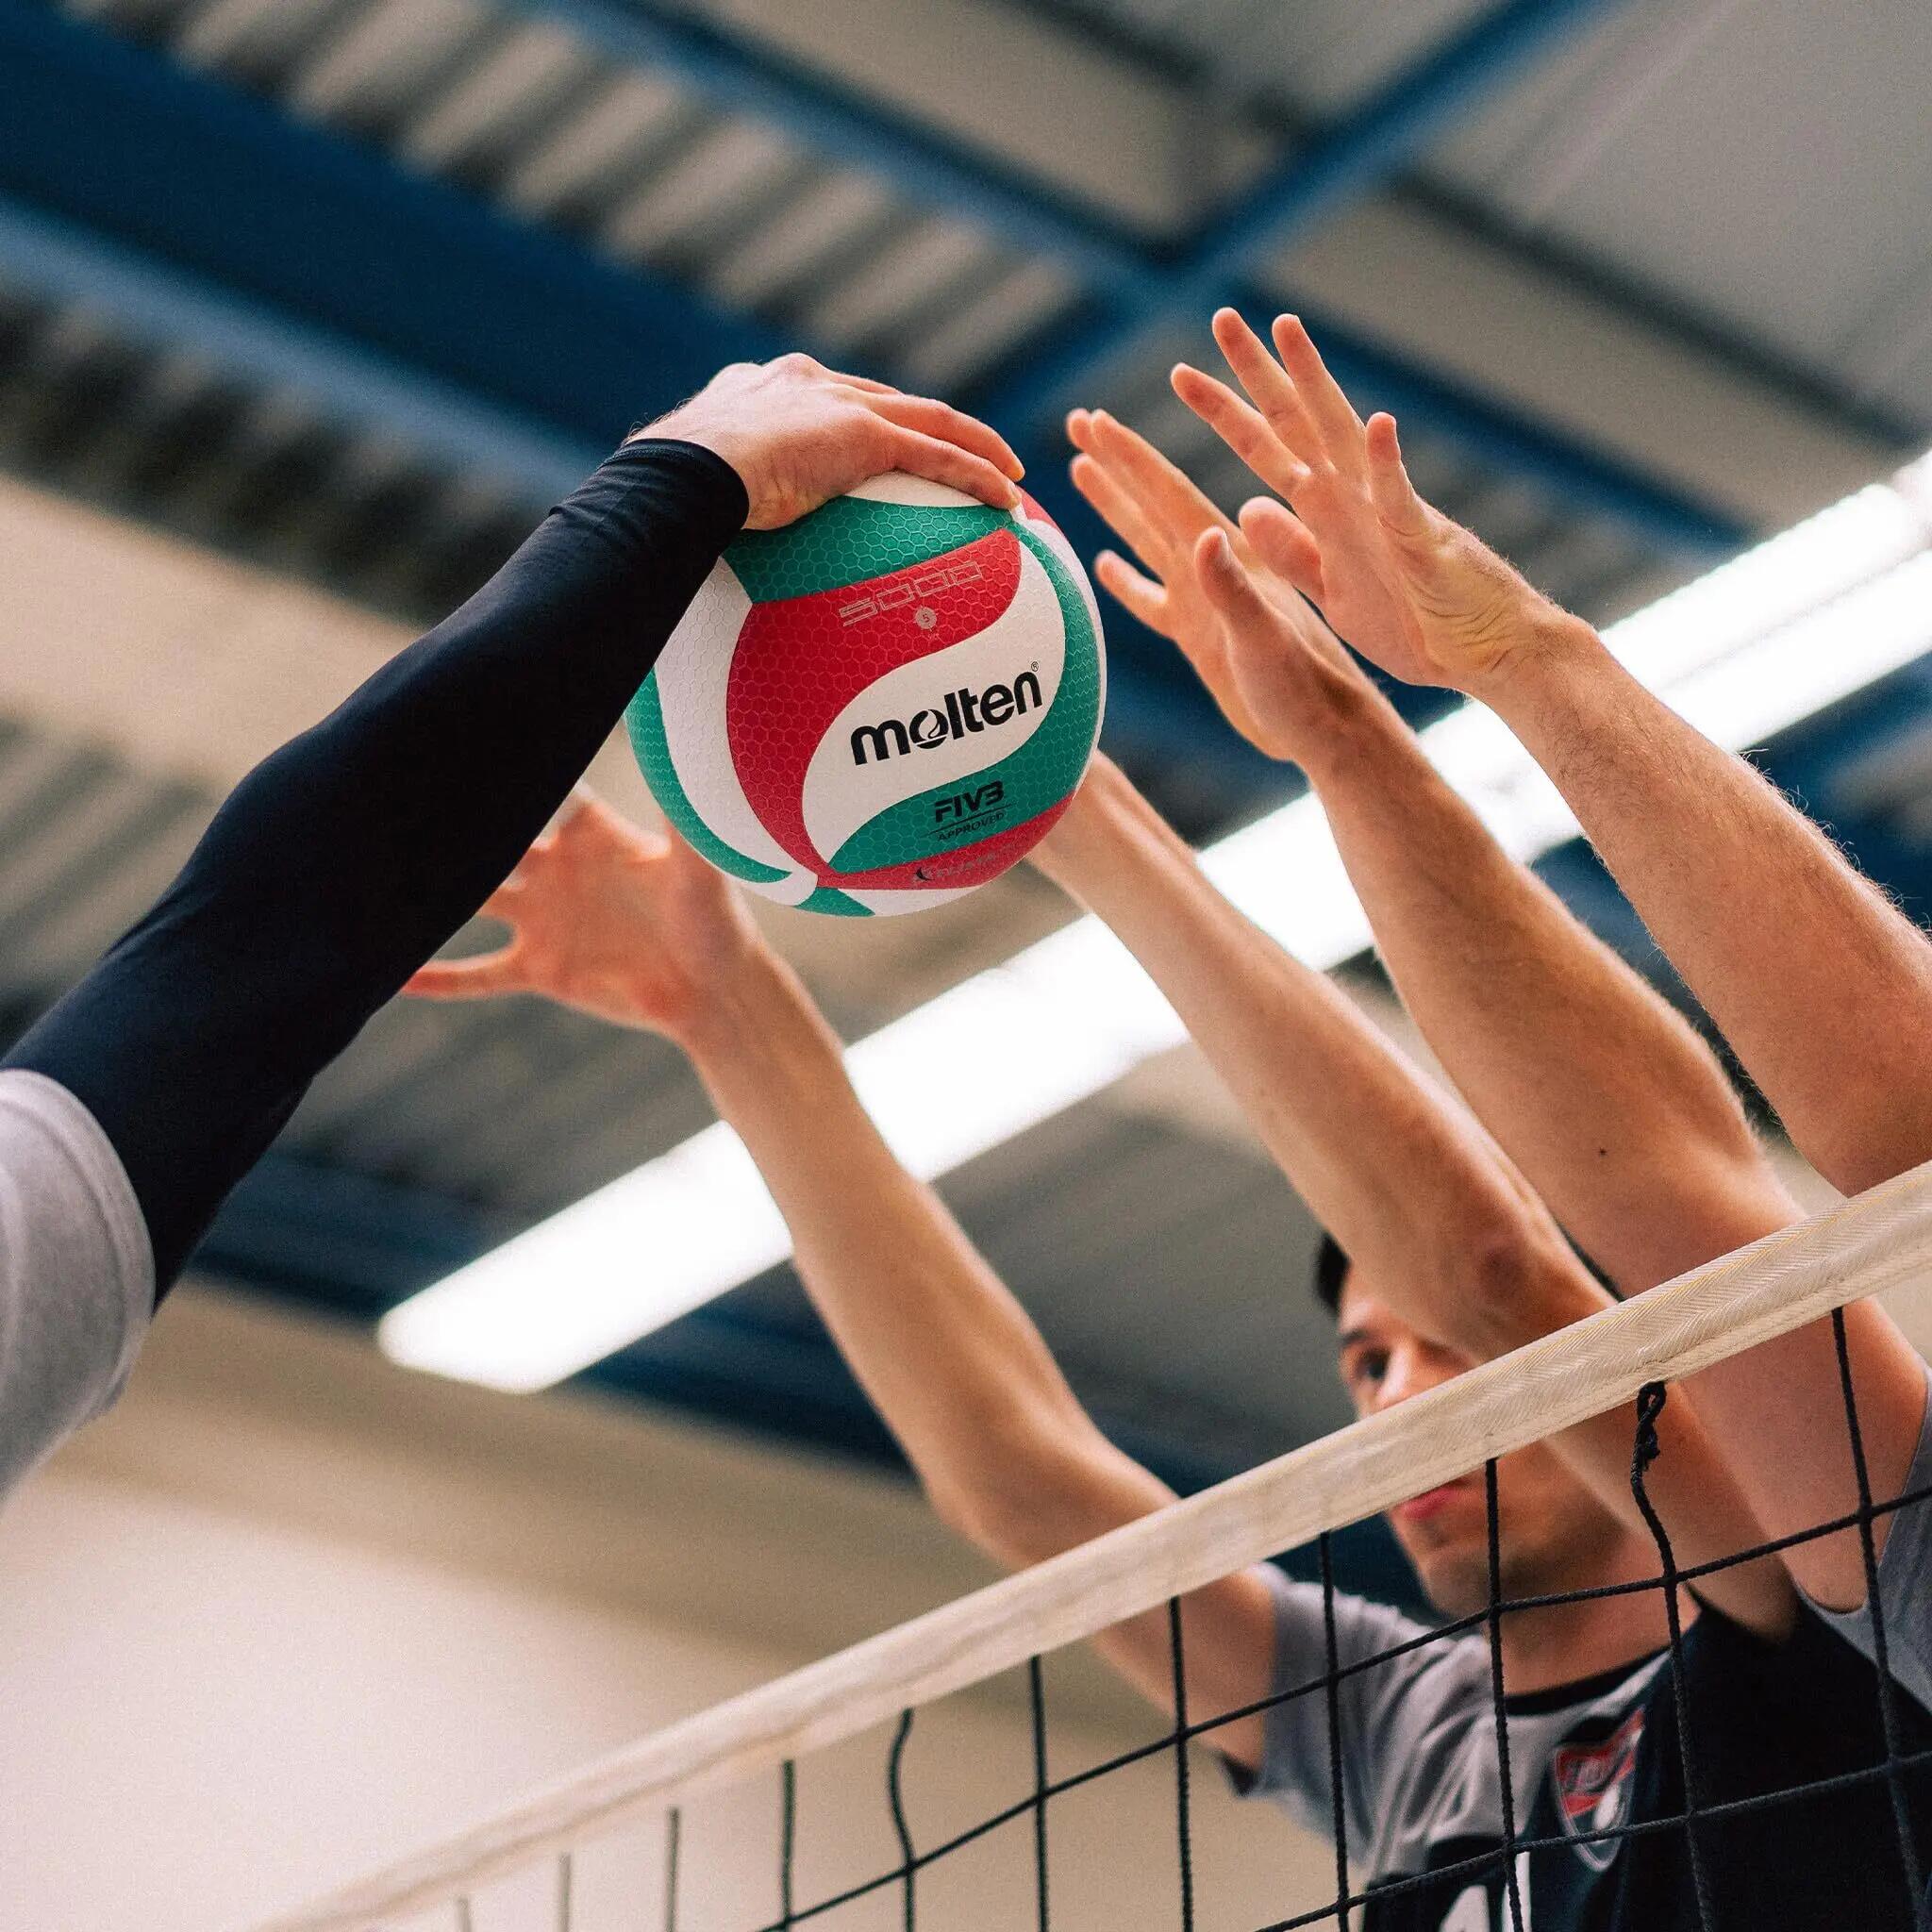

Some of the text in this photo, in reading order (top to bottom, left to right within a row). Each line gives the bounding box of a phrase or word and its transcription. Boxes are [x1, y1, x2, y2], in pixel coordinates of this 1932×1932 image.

[839, 560, 983, 626] 5000
[850, 671, 1043, 766] molten
[934, 780, 1005, 824] FIVB
[938, 809, 1006, 841] APPROVED
